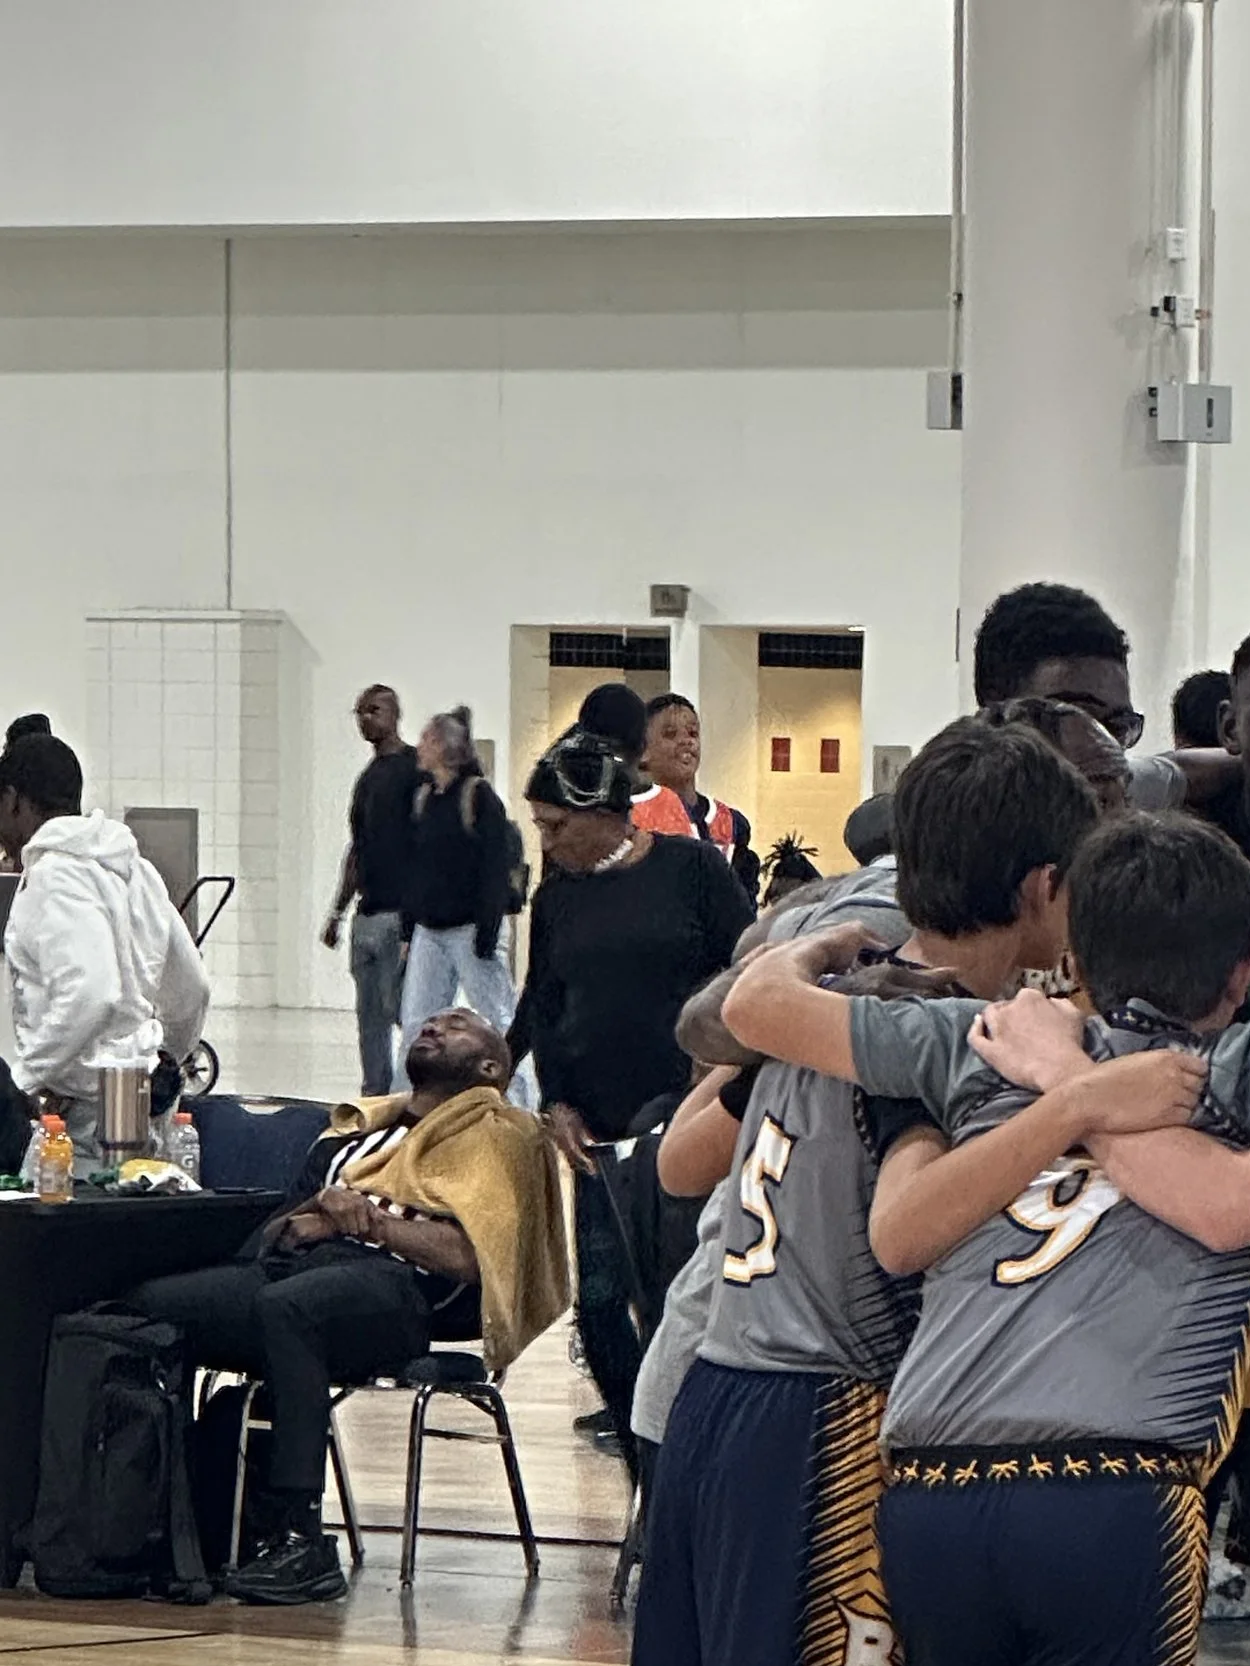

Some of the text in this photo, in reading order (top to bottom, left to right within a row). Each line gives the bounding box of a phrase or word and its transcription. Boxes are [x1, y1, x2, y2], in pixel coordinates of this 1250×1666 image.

[182, 1155, 194, 1168] G
[723, 1110, 799, 1288] 5
[990, 1145, 1121, 1289] 9
